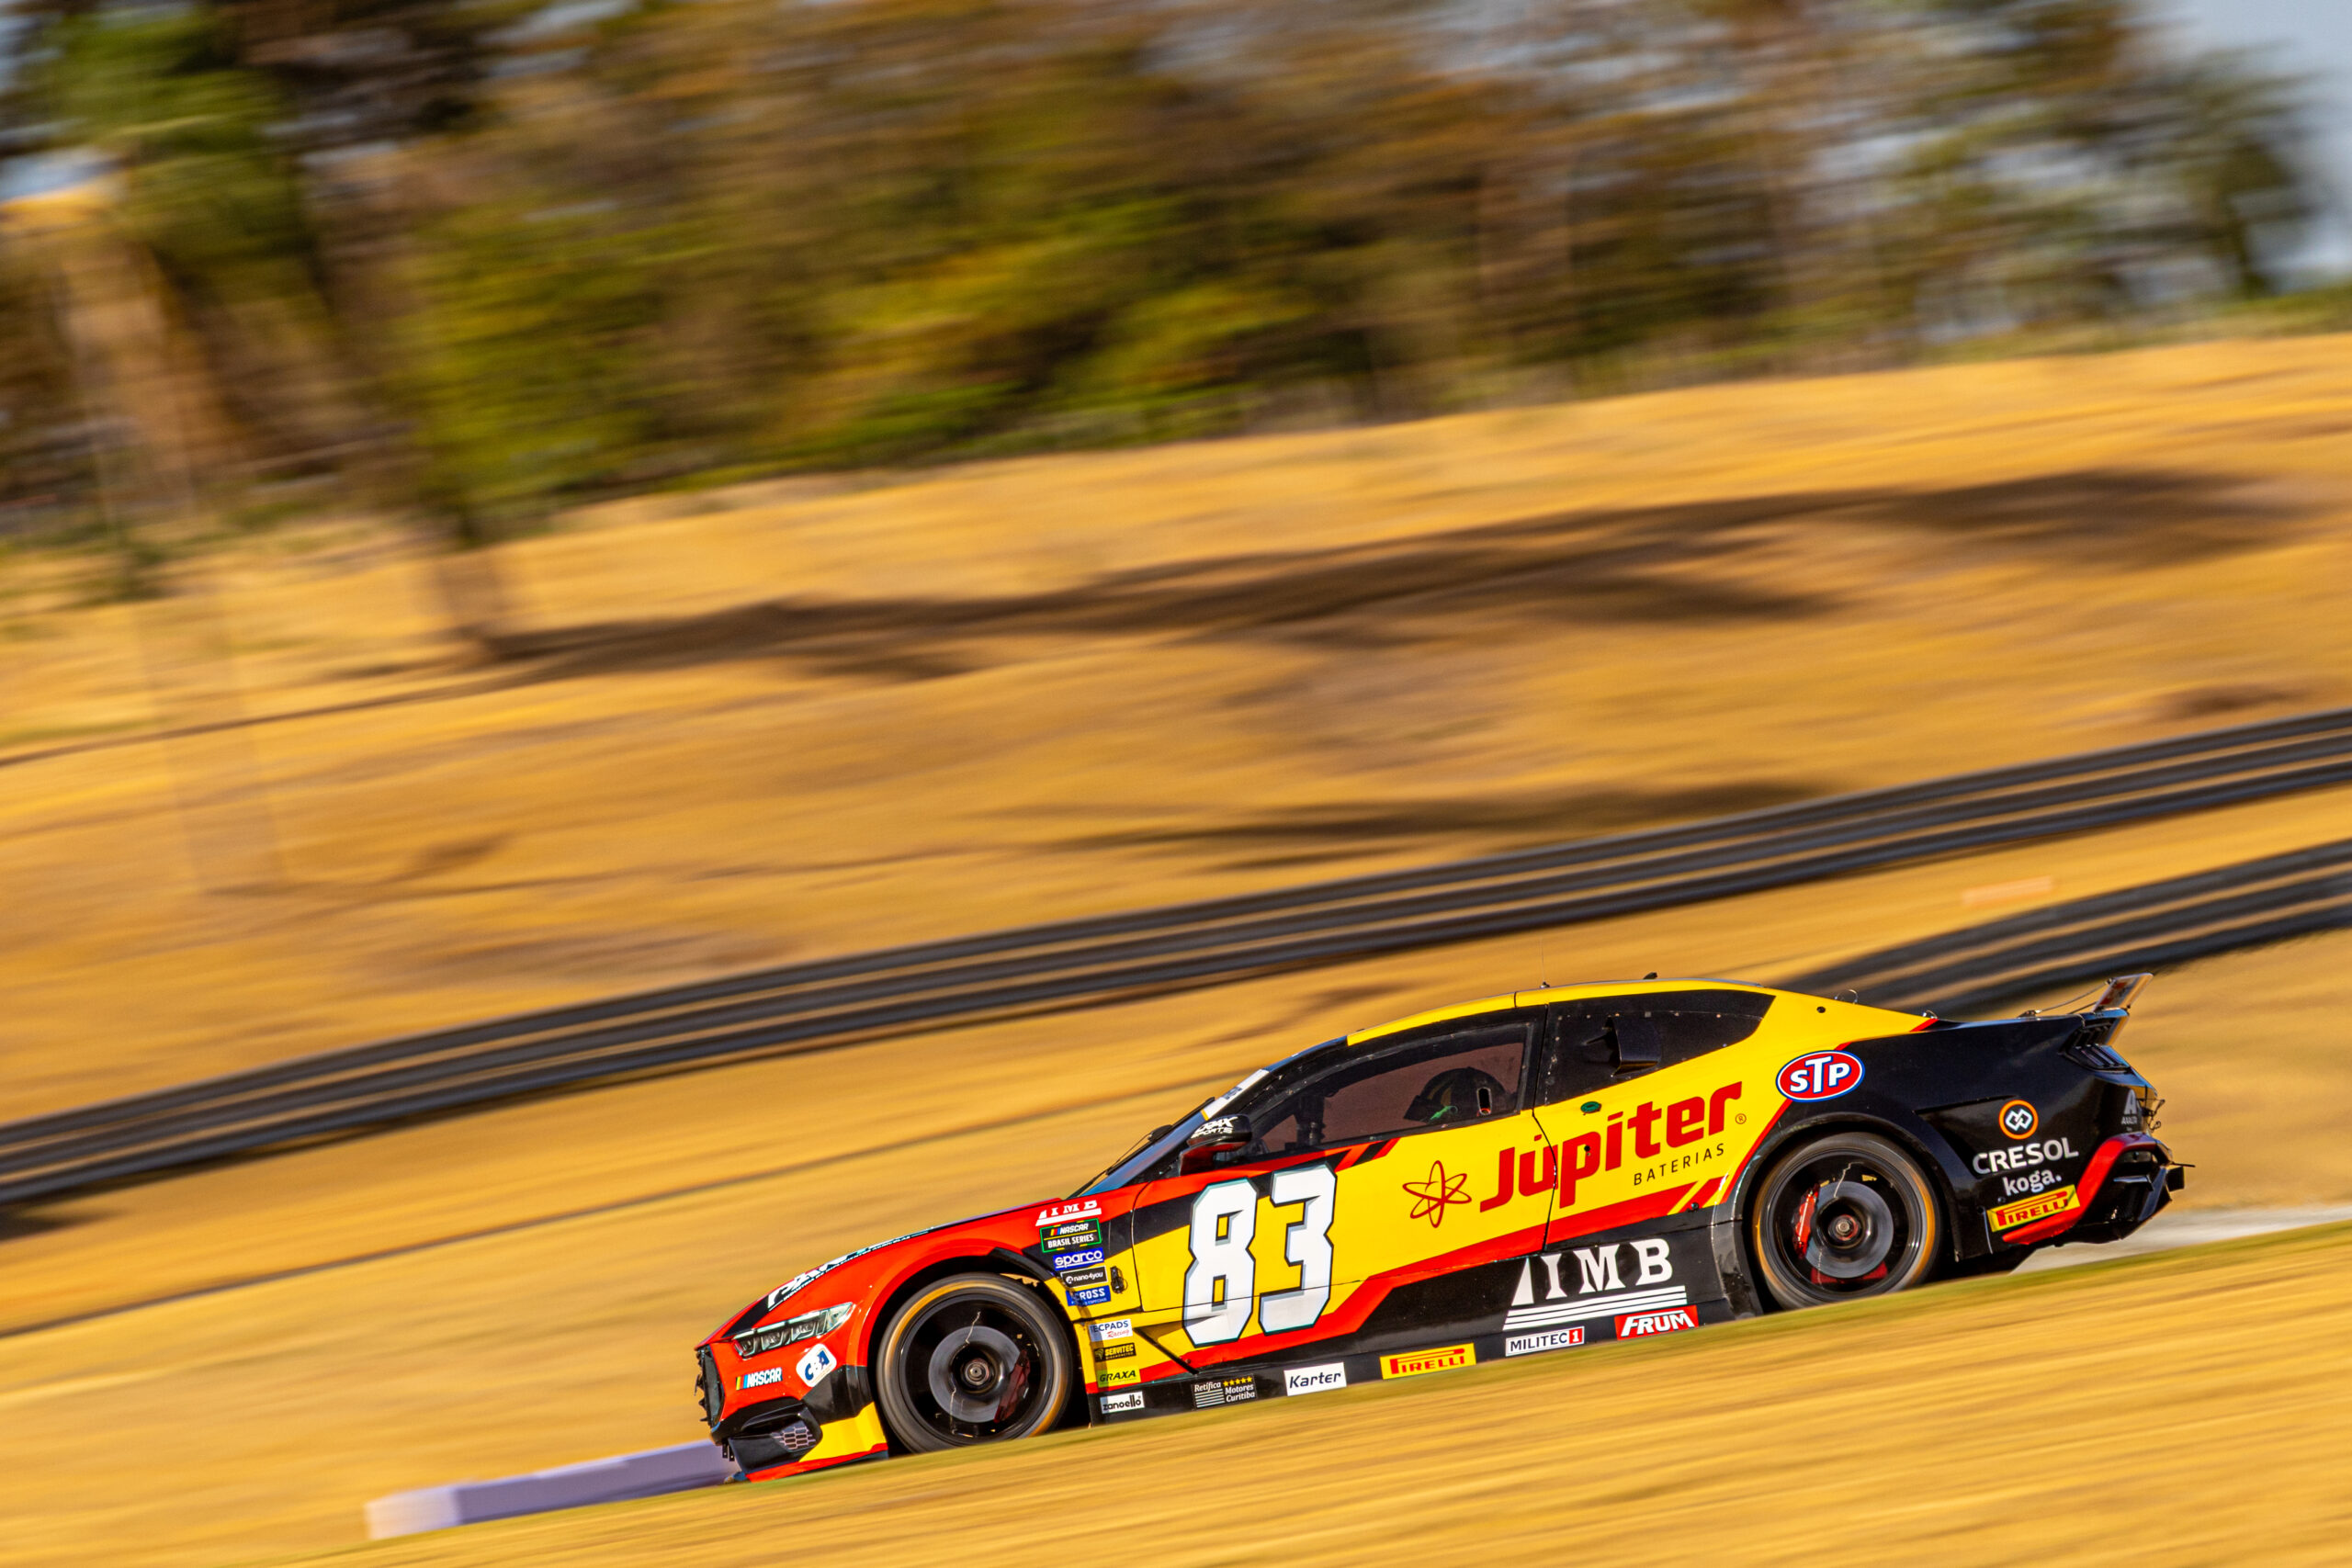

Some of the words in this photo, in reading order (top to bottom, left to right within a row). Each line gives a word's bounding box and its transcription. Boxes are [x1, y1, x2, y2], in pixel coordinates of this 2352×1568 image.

[1789, 1055, 1851, 1094] STP
[1973, 1137, 2079, 1174] CRESOL
[1634, 1143, 1724, 1186] BATERIAS
[1996, 1190, 2068, 1226] PIRELLI
[1059, 1224, 1089, 1235] NASCAR
[1048, 1236, 1071, 1248] BRASIL
[1071, 1234, 1094, 1245] SERIES
[1055, 1250, 1102, 1269] sparco
[1182, 1161, 1338, 1348] 83
[1073, 1272, 1103, 1282] nano4you
[1090, 1320, 1129, 1333] TECPADS
[1620, 1309, 1695, 1337] FRUM
[1104, 1344, 1134, 1356] SERVITEC
[1510, 1332, 1567, 1352] MILITEC
[1389, 1348, 1465, 1375] PIRELLI
[747, 1367, 782, 1388] NASCAR
[1100, 1370, 1136, 1382] GRAXA
[1289, 1371, 1341, 1388] Karter
[1194, 1381, 1221, 1393] Retífica
[1225, 1383, 1254, 1394] Motores
[1103, 1394, 1141, 1411] zanoello
[1226, 1391, 1256, 1403] Curitiba
